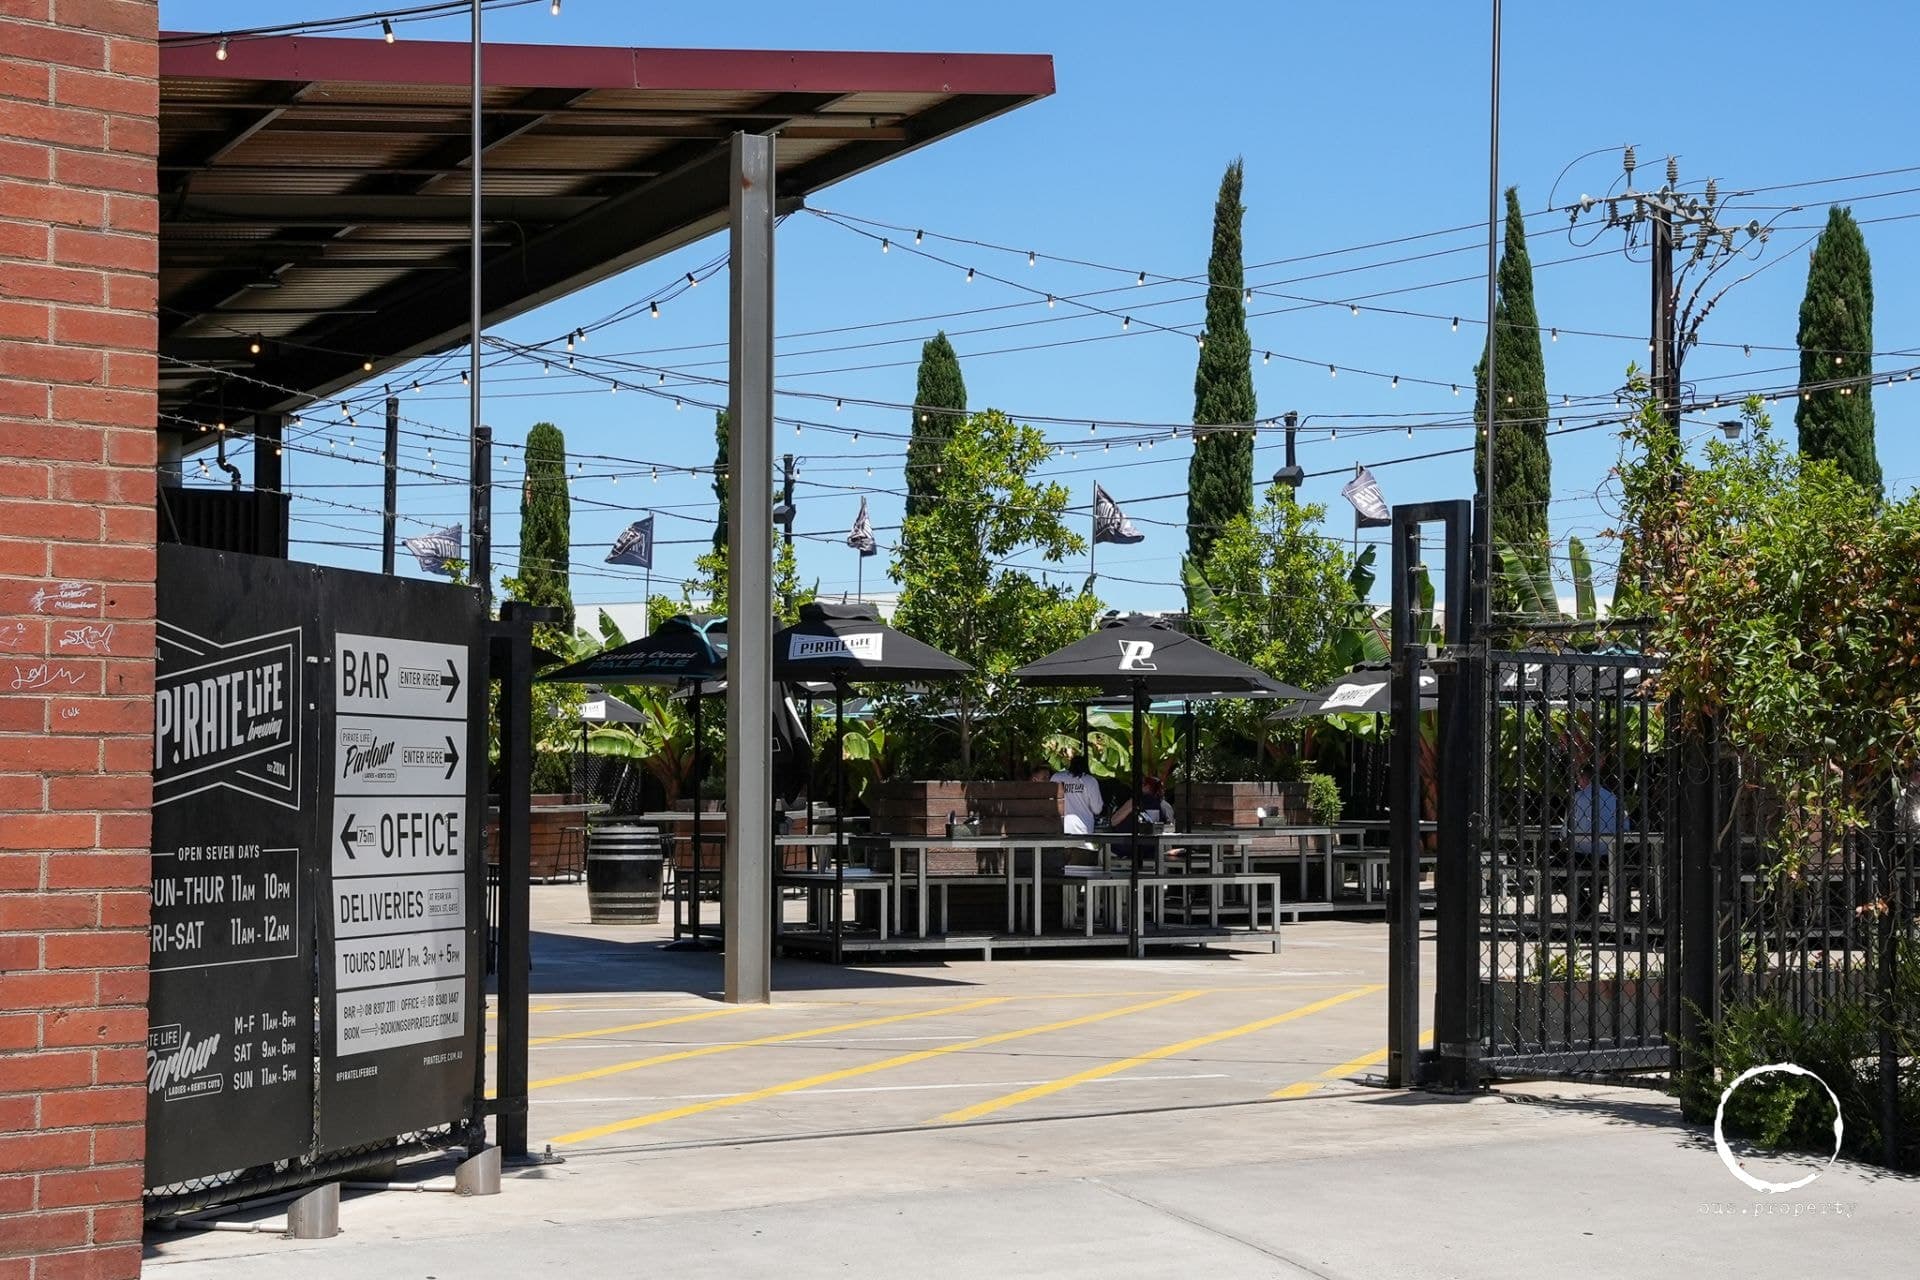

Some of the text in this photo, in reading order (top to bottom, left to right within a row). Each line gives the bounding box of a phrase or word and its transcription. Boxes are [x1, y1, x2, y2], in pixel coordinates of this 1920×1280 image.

[343, 649, 440, 699] BAR ENTER HERE
[247, 717, 282, 742] brewing
[342, 732, 370, 743] PIRATE LIFE
[403, 750, 443, 765] ENTER HERE
[273, 760, 285, 777] 2014
[359, 812, 458, 858] 75m OFFICE
[178, 844, 260, 861] OPEN SEVEN DAYS
[154, 872, 290, 907] UN-THUR 11AM 10PM
[341, 890, 424, 924] DELIVERIES
[152, 921, 205, 953] RI-SAT
[231, 917, 255, 945] 11AM
[264, 915, 290, 943] 12AM
[343, 951, 375, 974] TOURS
[379, 948, 404, 970] DAILY
[423, 946, 437, 965] 3PM
[446, 943, 460, 963] 5PM
[344, 1006, 356, 1019] BAR
[401, 997, 419, 1010] OFFICE
[234, 1015, 255, 1035] M-F
[344, 1027, 360, 1040] BOOK
[161, 1031, 177, 1045] LIFE
[234, 1043, 252, 1062] SAT
[168, 1085, 186, 1096] LADIES
[191, 1082, 207, 1092] GENTS
[207, 1079, 220, 1088] CUTS
[233, 1070, 253, 1090] SUN
